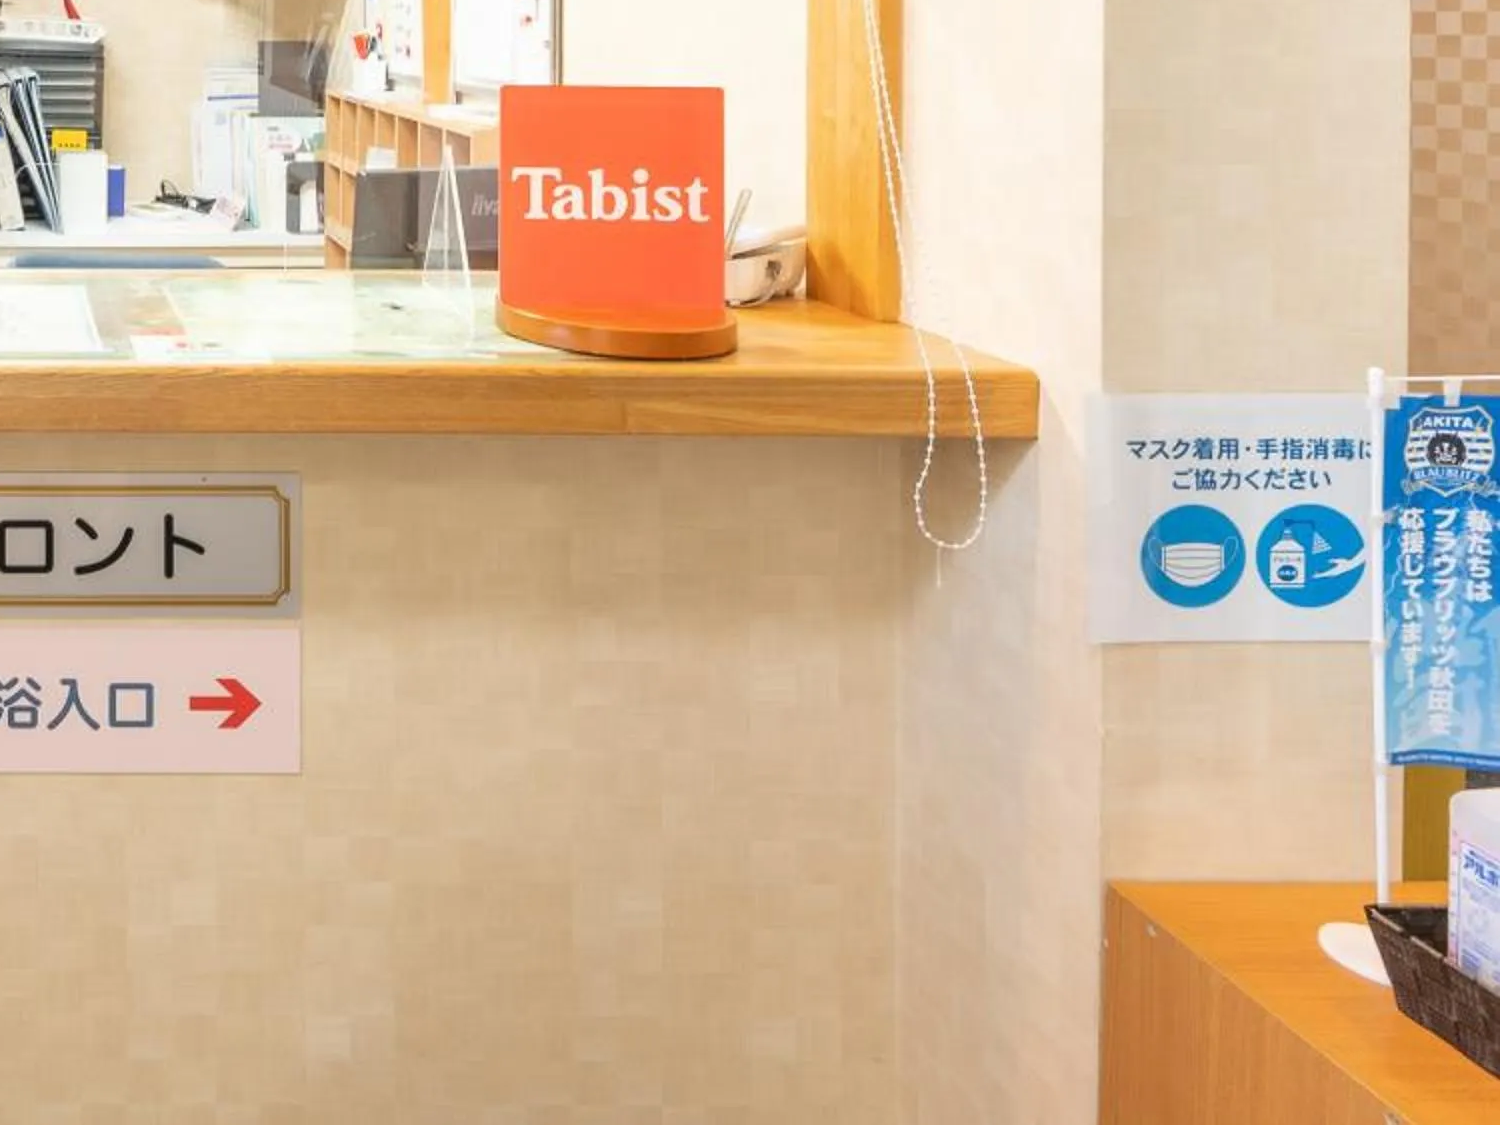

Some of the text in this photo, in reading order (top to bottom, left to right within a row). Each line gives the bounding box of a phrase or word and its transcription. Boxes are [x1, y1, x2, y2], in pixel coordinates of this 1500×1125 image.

[511, 166, 711, 223] Tabist
[1423, 416, 1473, 428] AKITA
[1125, 437, 1372, 462] マスク着用・手指消毒に
[1172, 467, 1333, 491] ご協力ください
[1465, 510, 1493, 603] 私たちは
